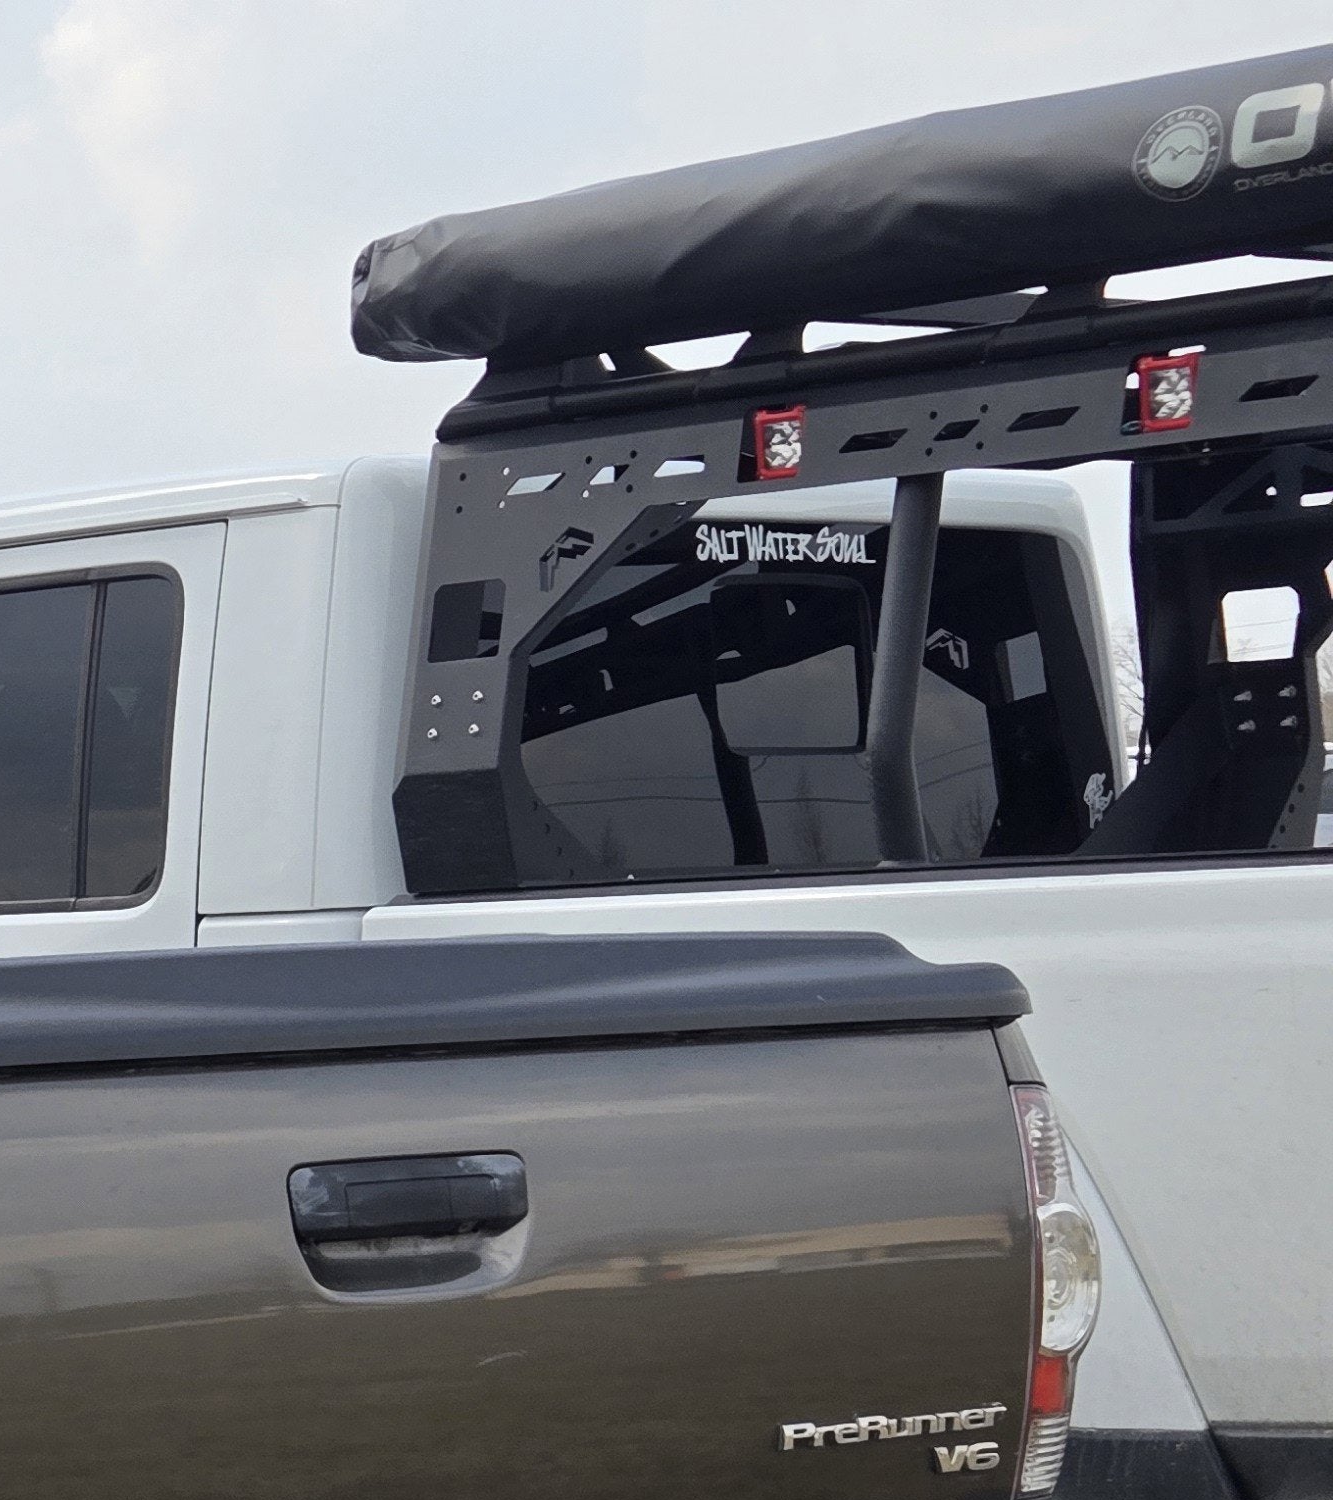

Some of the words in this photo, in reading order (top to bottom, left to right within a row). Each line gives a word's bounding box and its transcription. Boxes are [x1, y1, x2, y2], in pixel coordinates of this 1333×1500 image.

[1231, 79, 1333, 169] O
[744, 523, 817, 562] WATER
[781, 1402, 1008, 1450] PreRunner
[934, 1441, 1000, 1473] V6
